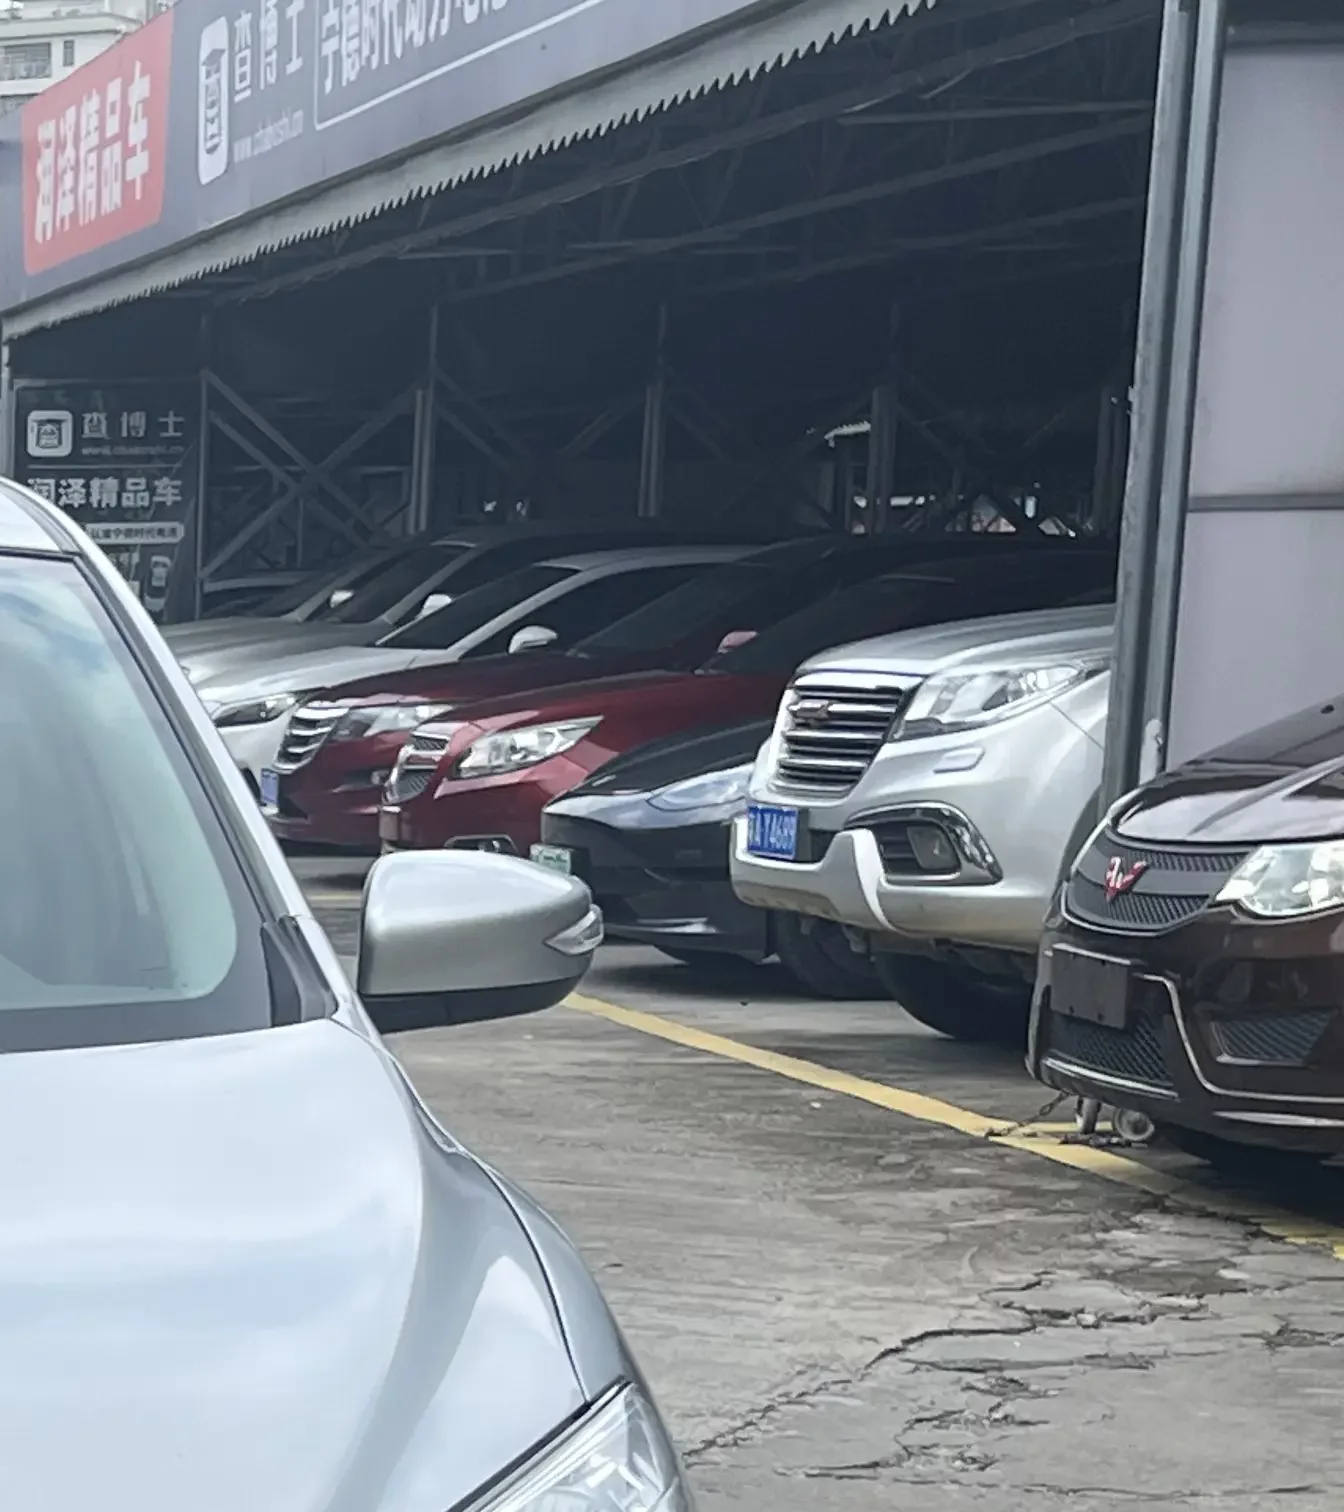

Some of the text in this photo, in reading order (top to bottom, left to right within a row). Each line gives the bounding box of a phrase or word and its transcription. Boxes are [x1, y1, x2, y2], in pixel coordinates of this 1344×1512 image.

[234, 0, 304, 103] 查博士
[321, 0, 507, 95] 宁德时代
[35, 60, 151, 243] 润泽精品车
[82, 410, 184, 439] 查博士
[27, 477, 182, 508] 润泽精品车
